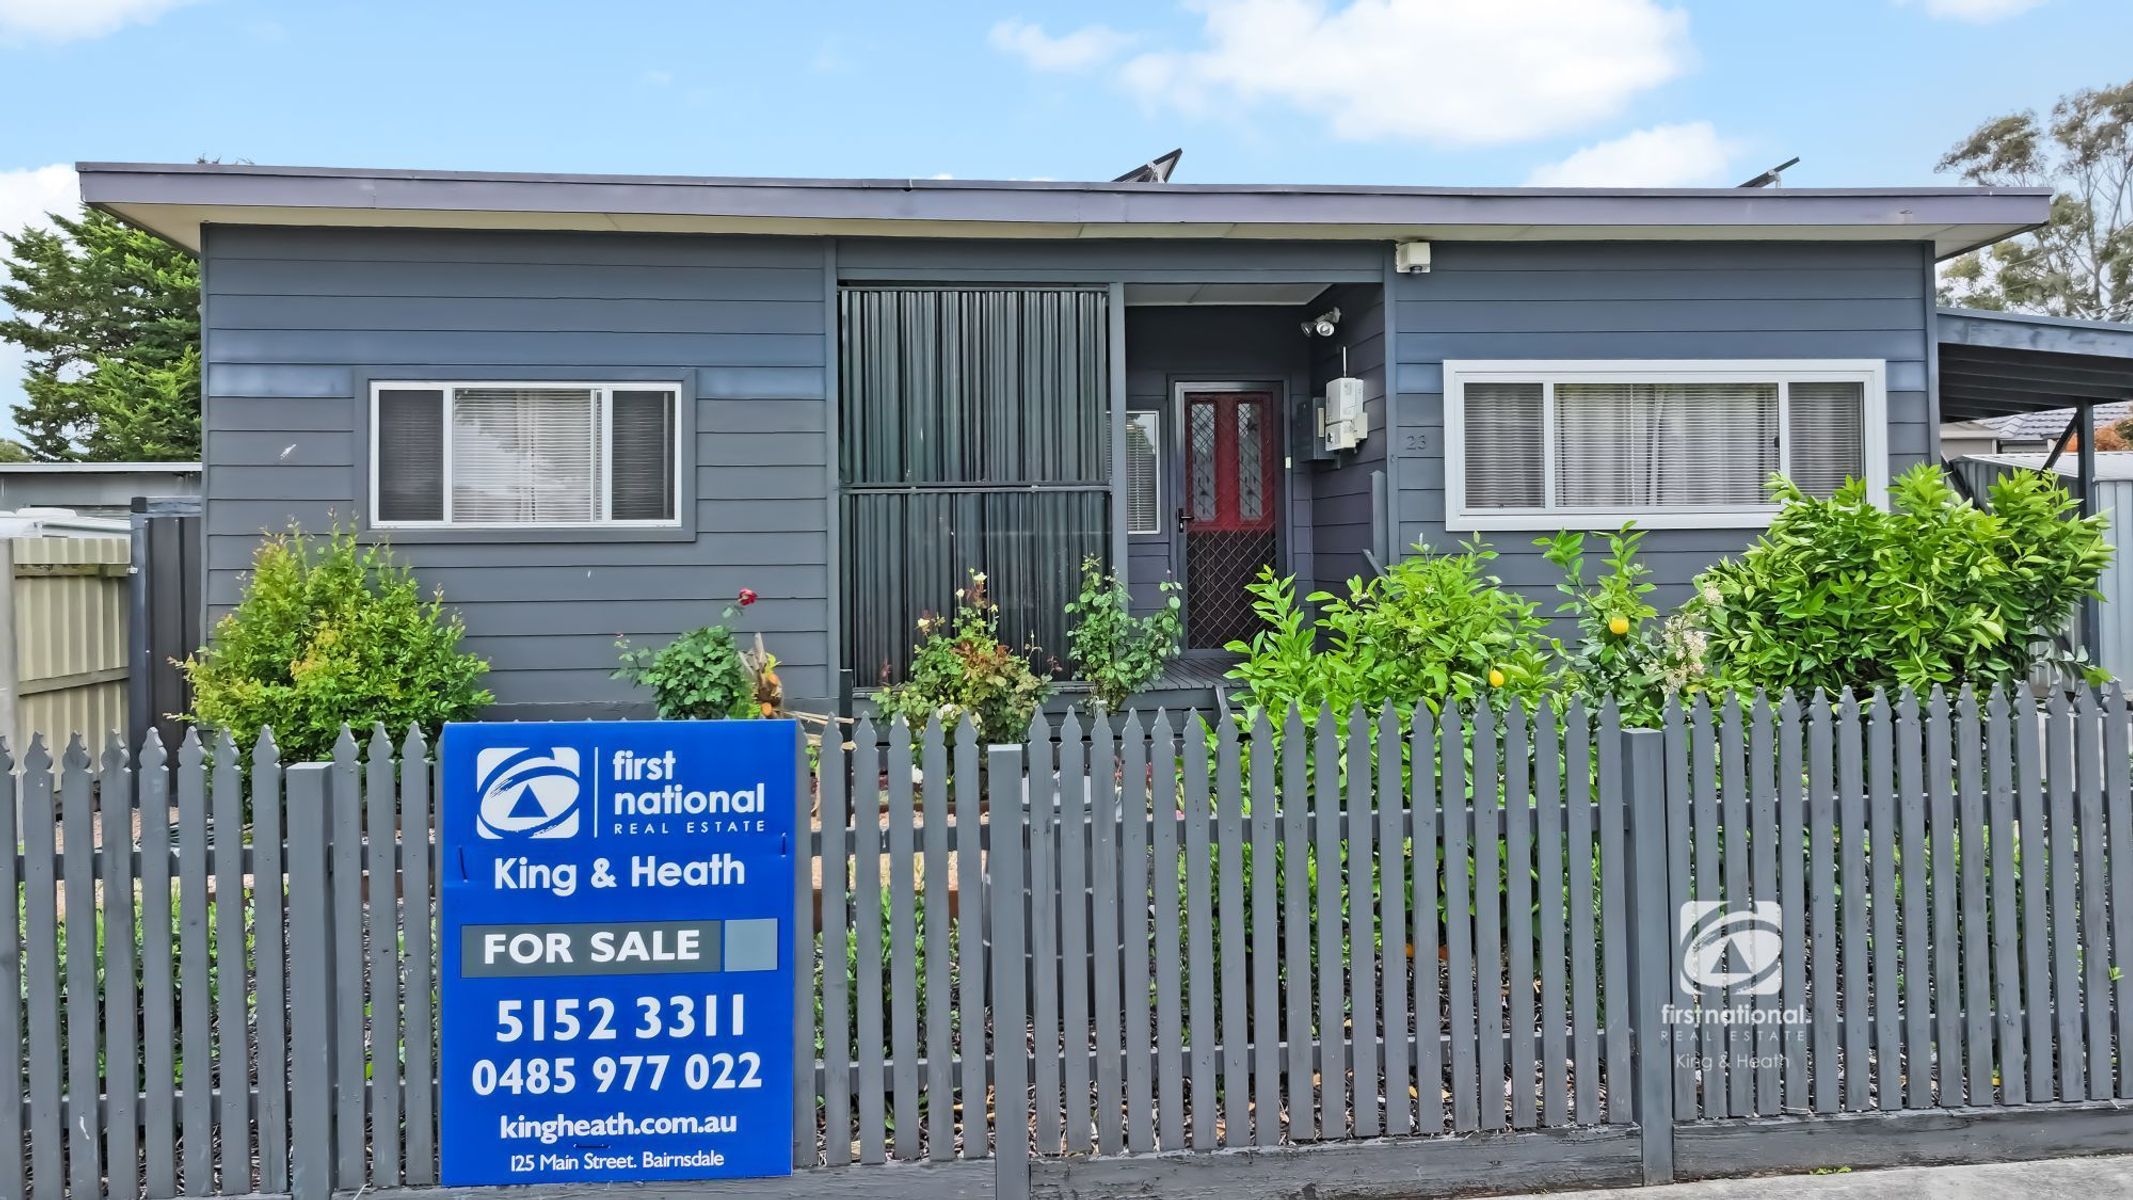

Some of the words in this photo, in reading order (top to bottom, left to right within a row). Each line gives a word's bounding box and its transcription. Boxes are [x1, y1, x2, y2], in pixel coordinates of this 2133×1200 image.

[1406, 434, 1427, 451] 23
[613, 751, 675, 780] first
[615, 783, 764, 814] national
[615, 823, 668, 833] REAL
[687, 821, 763, 832] ESTATE
[495, 857, 576, 896] King
[591, 858, 616, 888] &
[632, 854, 744, 886] Heath
[485, 934, 573, 964] FOR
[591, 930, 699, 962] SALE
[497, 998, 616, 1042] 5152
[636, 994, 743, 1038] 3311
[473, 1058, 575, 1095] 0485
[593, 1055, 670, 1092] 977
[685, 1052, 761, 1089] 022
[501, 1112, 736, 1143] kingheath.com.au
[512, 1155, 534, 1171] 125
[540, 1154, 578, 1170] Main
[643, 1150, 724, 1167] Bairnsdale
